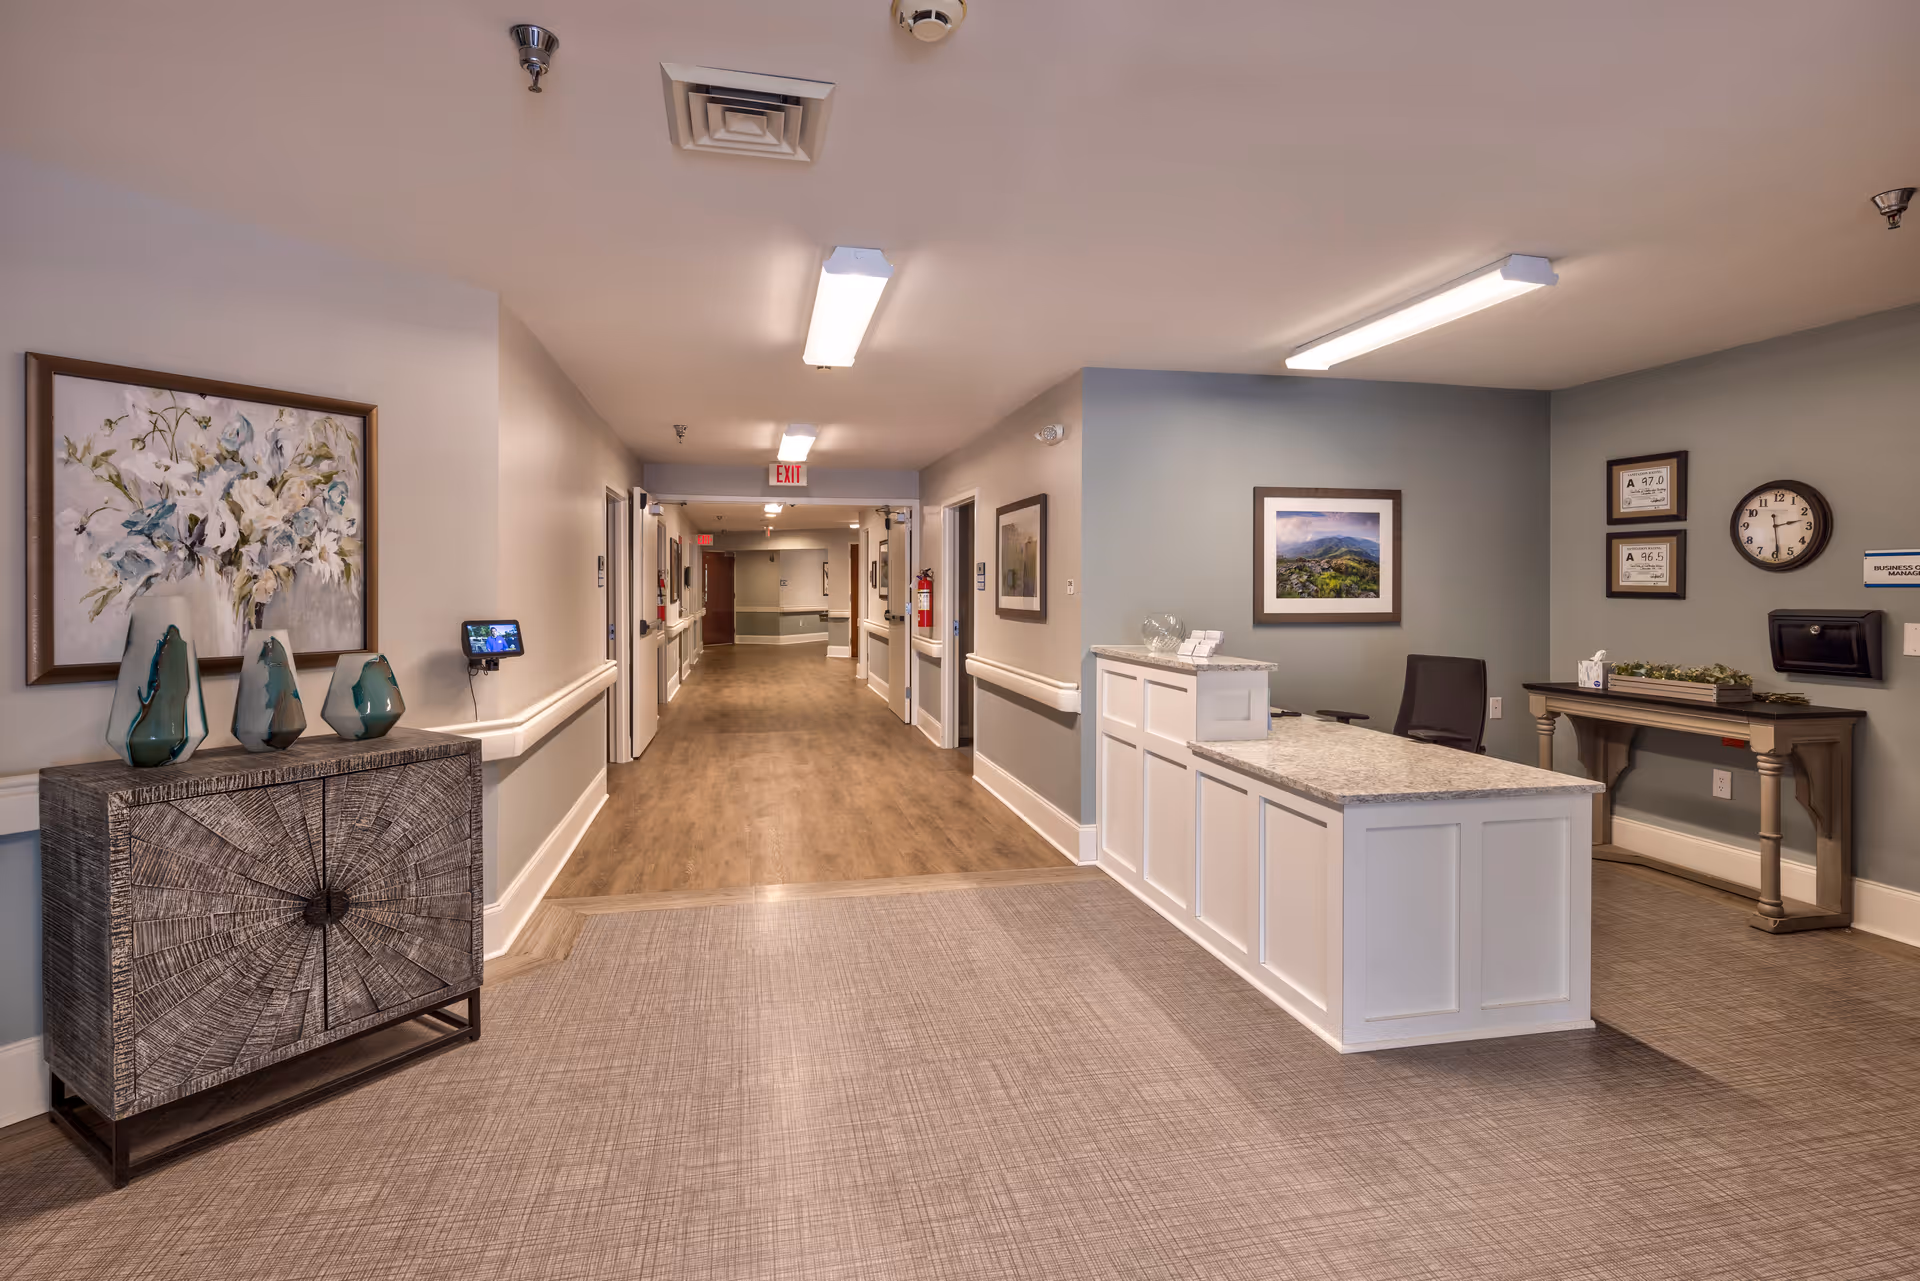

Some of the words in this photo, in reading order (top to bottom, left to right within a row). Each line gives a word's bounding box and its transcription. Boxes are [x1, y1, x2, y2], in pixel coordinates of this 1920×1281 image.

[776, 464, 801, 483] EXIT
[1627, 479, 1635, 488] A
[1773, 493, 1785, 502] 12
[1790, 496, 1797, 505] 1
[1759, 498, 1768, 507] 11
[1748, 508, 1758, 517] 10
[1801, 506, 1808, 516] 2
[1742, 521, 1750, 530] 9
[1805, 521, 1813, 530] 3
[1746, 535, 1753, 545] 8
[1798, 535, 1806, 545] 4
[1756, 546, 1763, 555] 7
[1771, 549, 1779, 559] 6
[1786, 546, 1794, 556] 5
[1626, 553, 1634, 561] A
